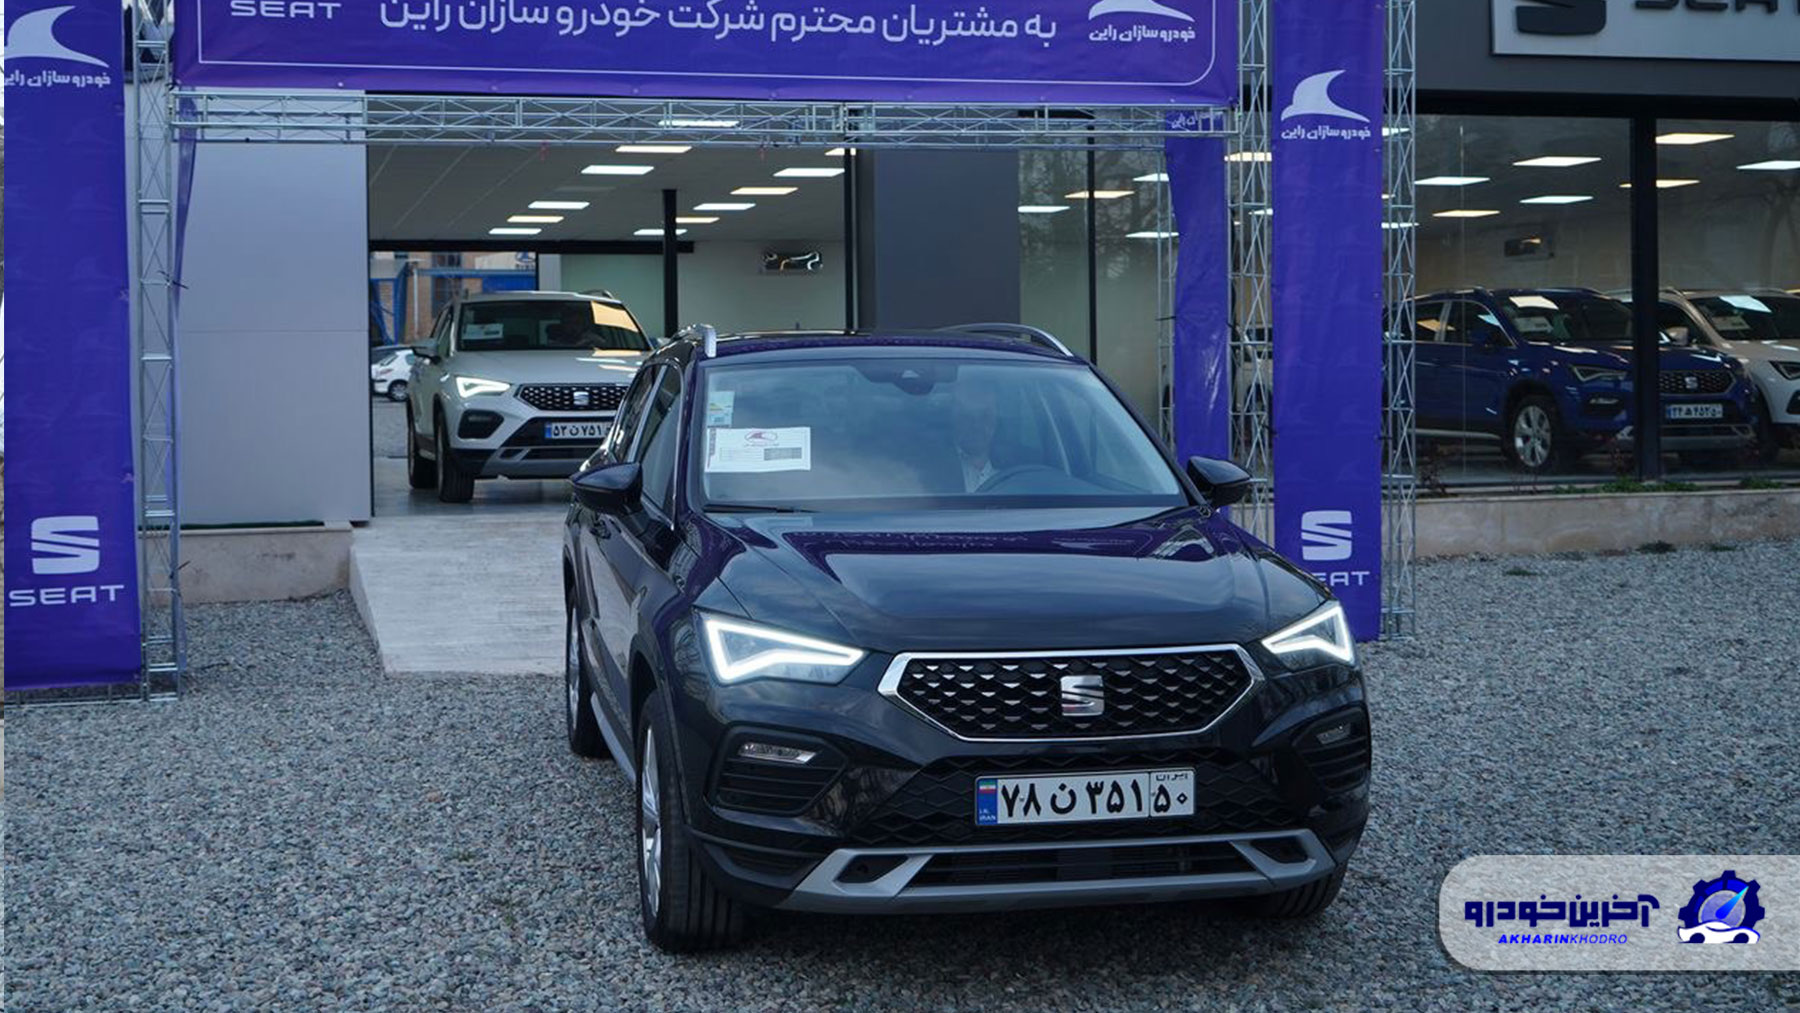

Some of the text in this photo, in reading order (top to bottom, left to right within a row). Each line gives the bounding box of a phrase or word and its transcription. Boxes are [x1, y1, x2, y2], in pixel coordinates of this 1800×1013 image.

[230, 0, 342, 19] SEAT
[668, 0, 765, 39] شرکت
[771, 7, 876, 42] محترم
[882, 4, 1019, 46] مشتریان
[1024, 14, 1056, 48] به
[1088, 24, 1196, 43] خودرو سازان راین
[27, 70, 71, 88] سازان
[72, 72, 111, 89] خودرو
[1281, 125, 1371, 140] خودرو سازان راین
[9, 584, 124, 607] SEAT
